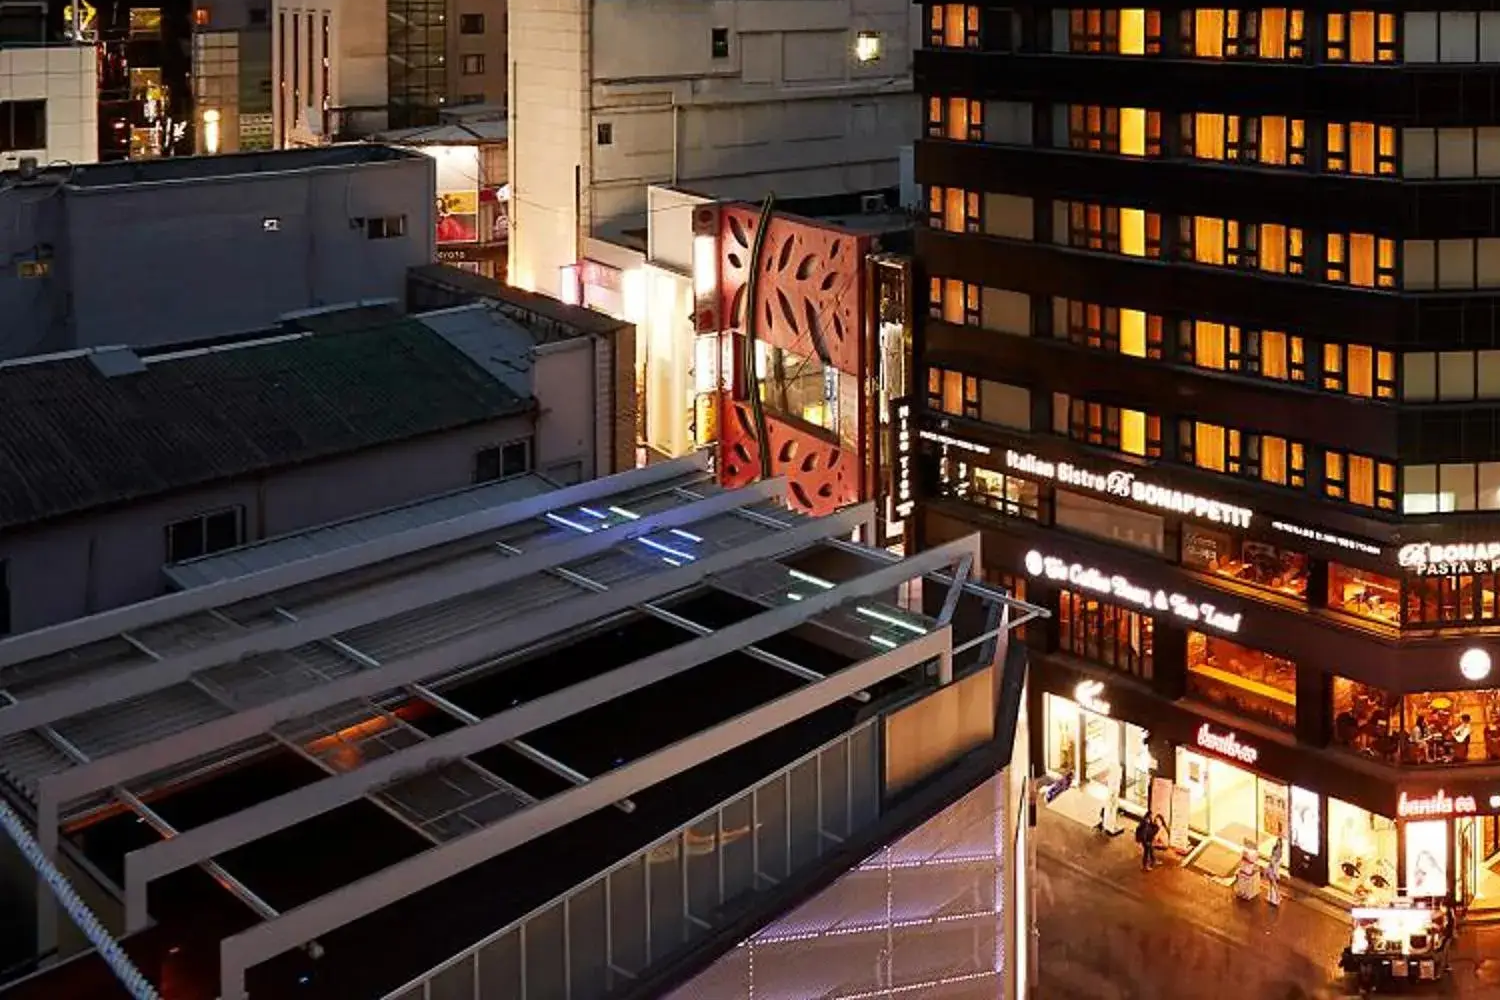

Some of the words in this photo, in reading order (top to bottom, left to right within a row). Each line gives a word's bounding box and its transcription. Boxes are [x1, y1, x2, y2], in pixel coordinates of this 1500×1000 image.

[1006, 450, 1054, 478] Italian
[1057, 462, 1106, 491] Bistro
[1131, 481, 1253, 528] BONAPPETIT
[1417, 563, 1469, 575] PASTA
[1475, 561, 1487, 573] &
